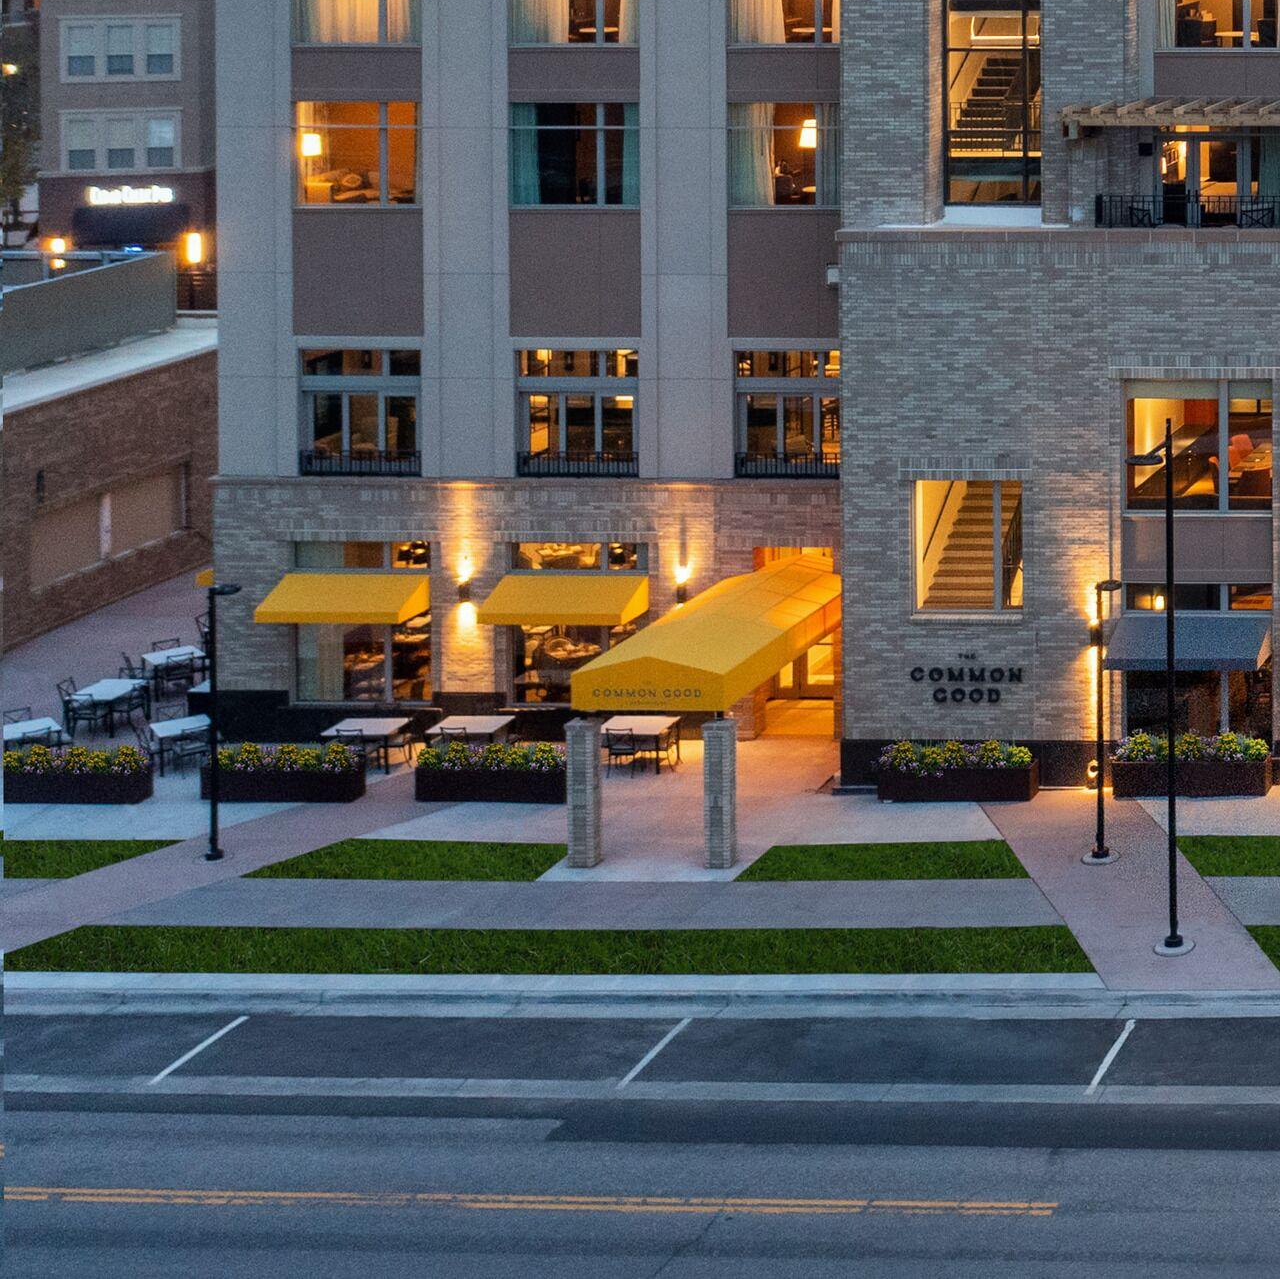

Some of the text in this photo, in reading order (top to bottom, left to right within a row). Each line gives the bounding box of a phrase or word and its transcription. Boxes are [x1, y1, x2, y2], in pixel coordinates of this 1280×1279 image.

[910, 666, 1023, 682] COMMON
[592, 688, 702, 698] COMMON GOOD
[933, 687, 1001, 703] GOOD
